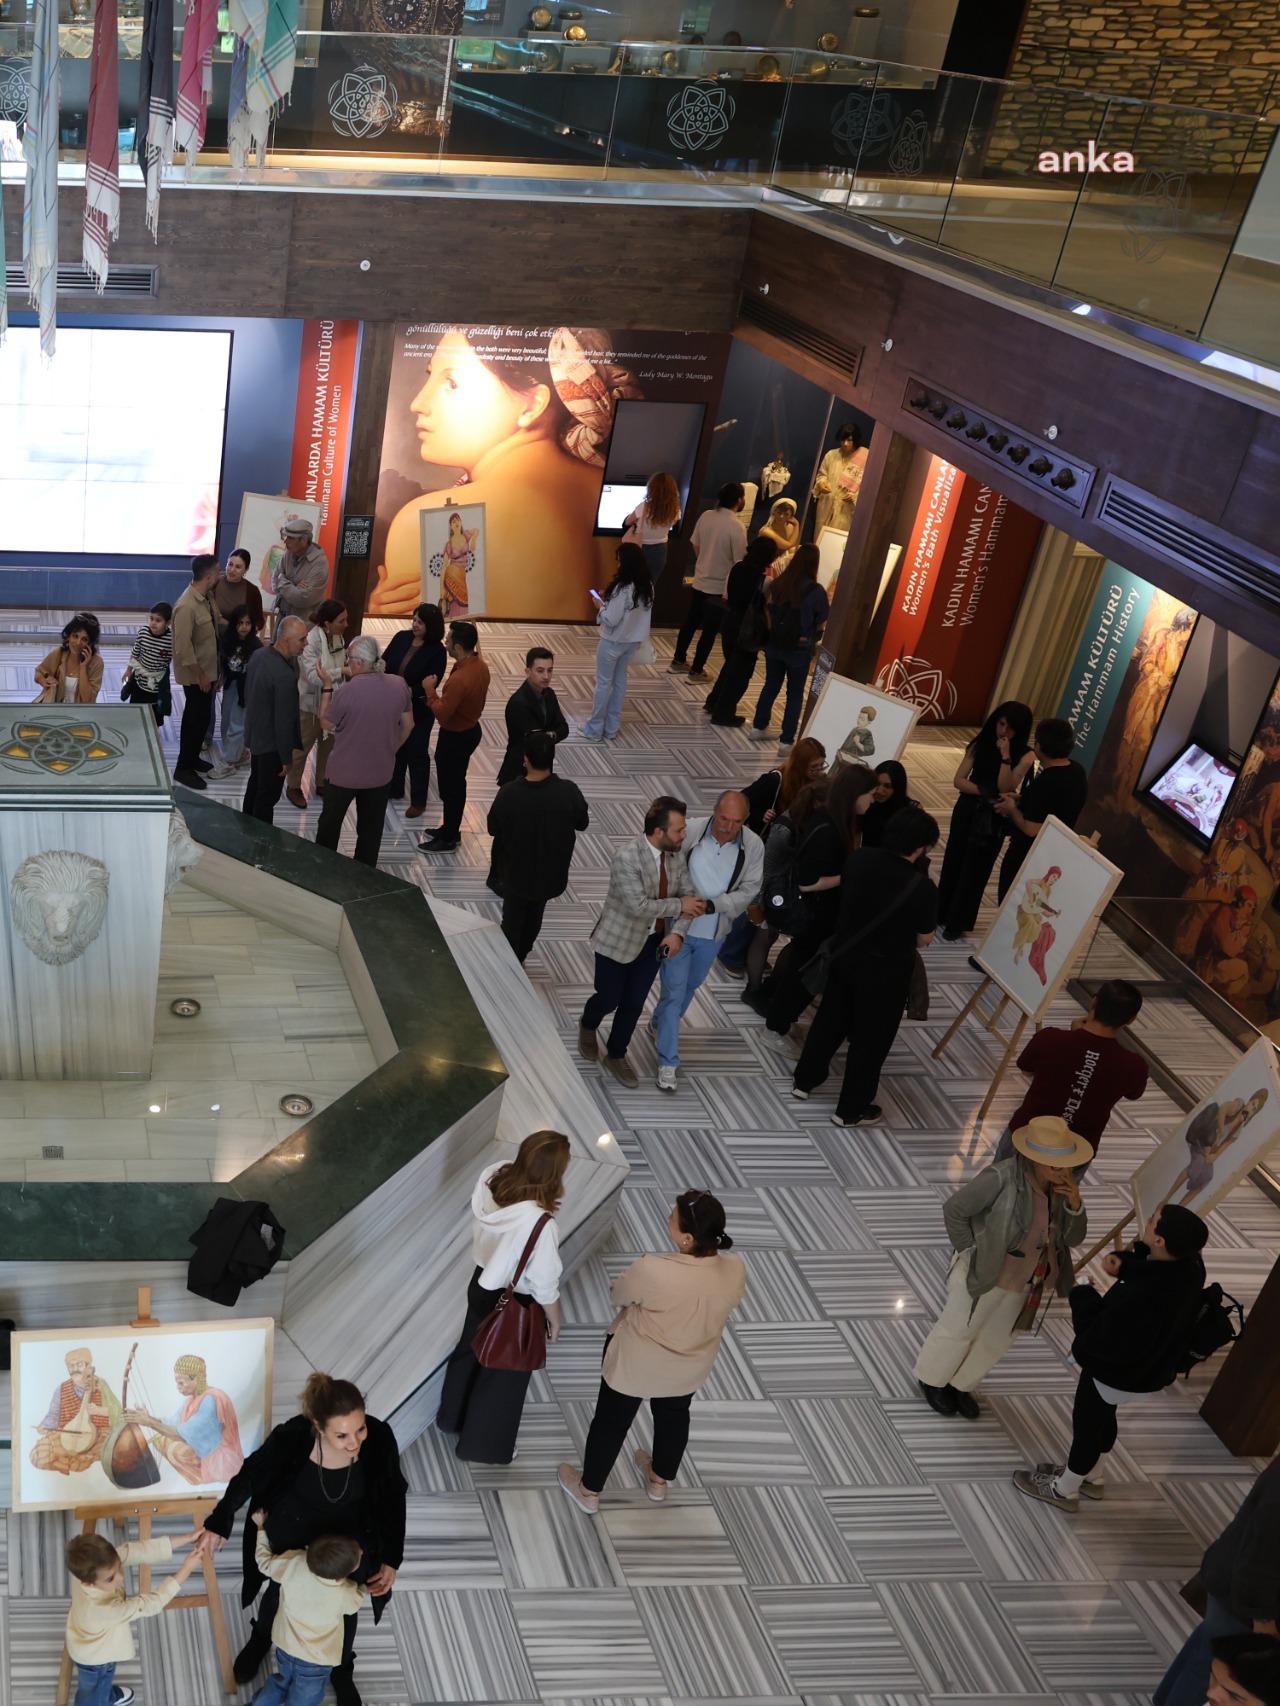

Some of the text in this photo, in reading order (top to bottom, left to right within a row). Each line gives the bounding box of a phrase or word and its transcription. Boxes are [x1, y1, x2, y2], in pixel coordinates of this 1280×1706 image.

[505, 325, 524, 336] beni
[525, 327, 539, 339] çok
[639, 370, 655, 380] Lady
[657, 371, 674, 381] Mary
[305, 320, 334, 503] INLARDA HAMAM KÜLTÜRÜ
[328, 385, 342, 424] Women
[327, 426, 337, 437] of
[323, 438, 336, 476] Culture
[902, 570, 918, 613] KADIN
[914, 511, 935, 568] HAMAMI
[926, 528, 939, 559] Bath
[941, 583, 965, 627] KADIN
[955, 518, 984, 578] HAMAMI
[1087, 584, 1123, 670] KÜLTÜRÜ
[1074, 587, 1141, 749] The Hammam History
